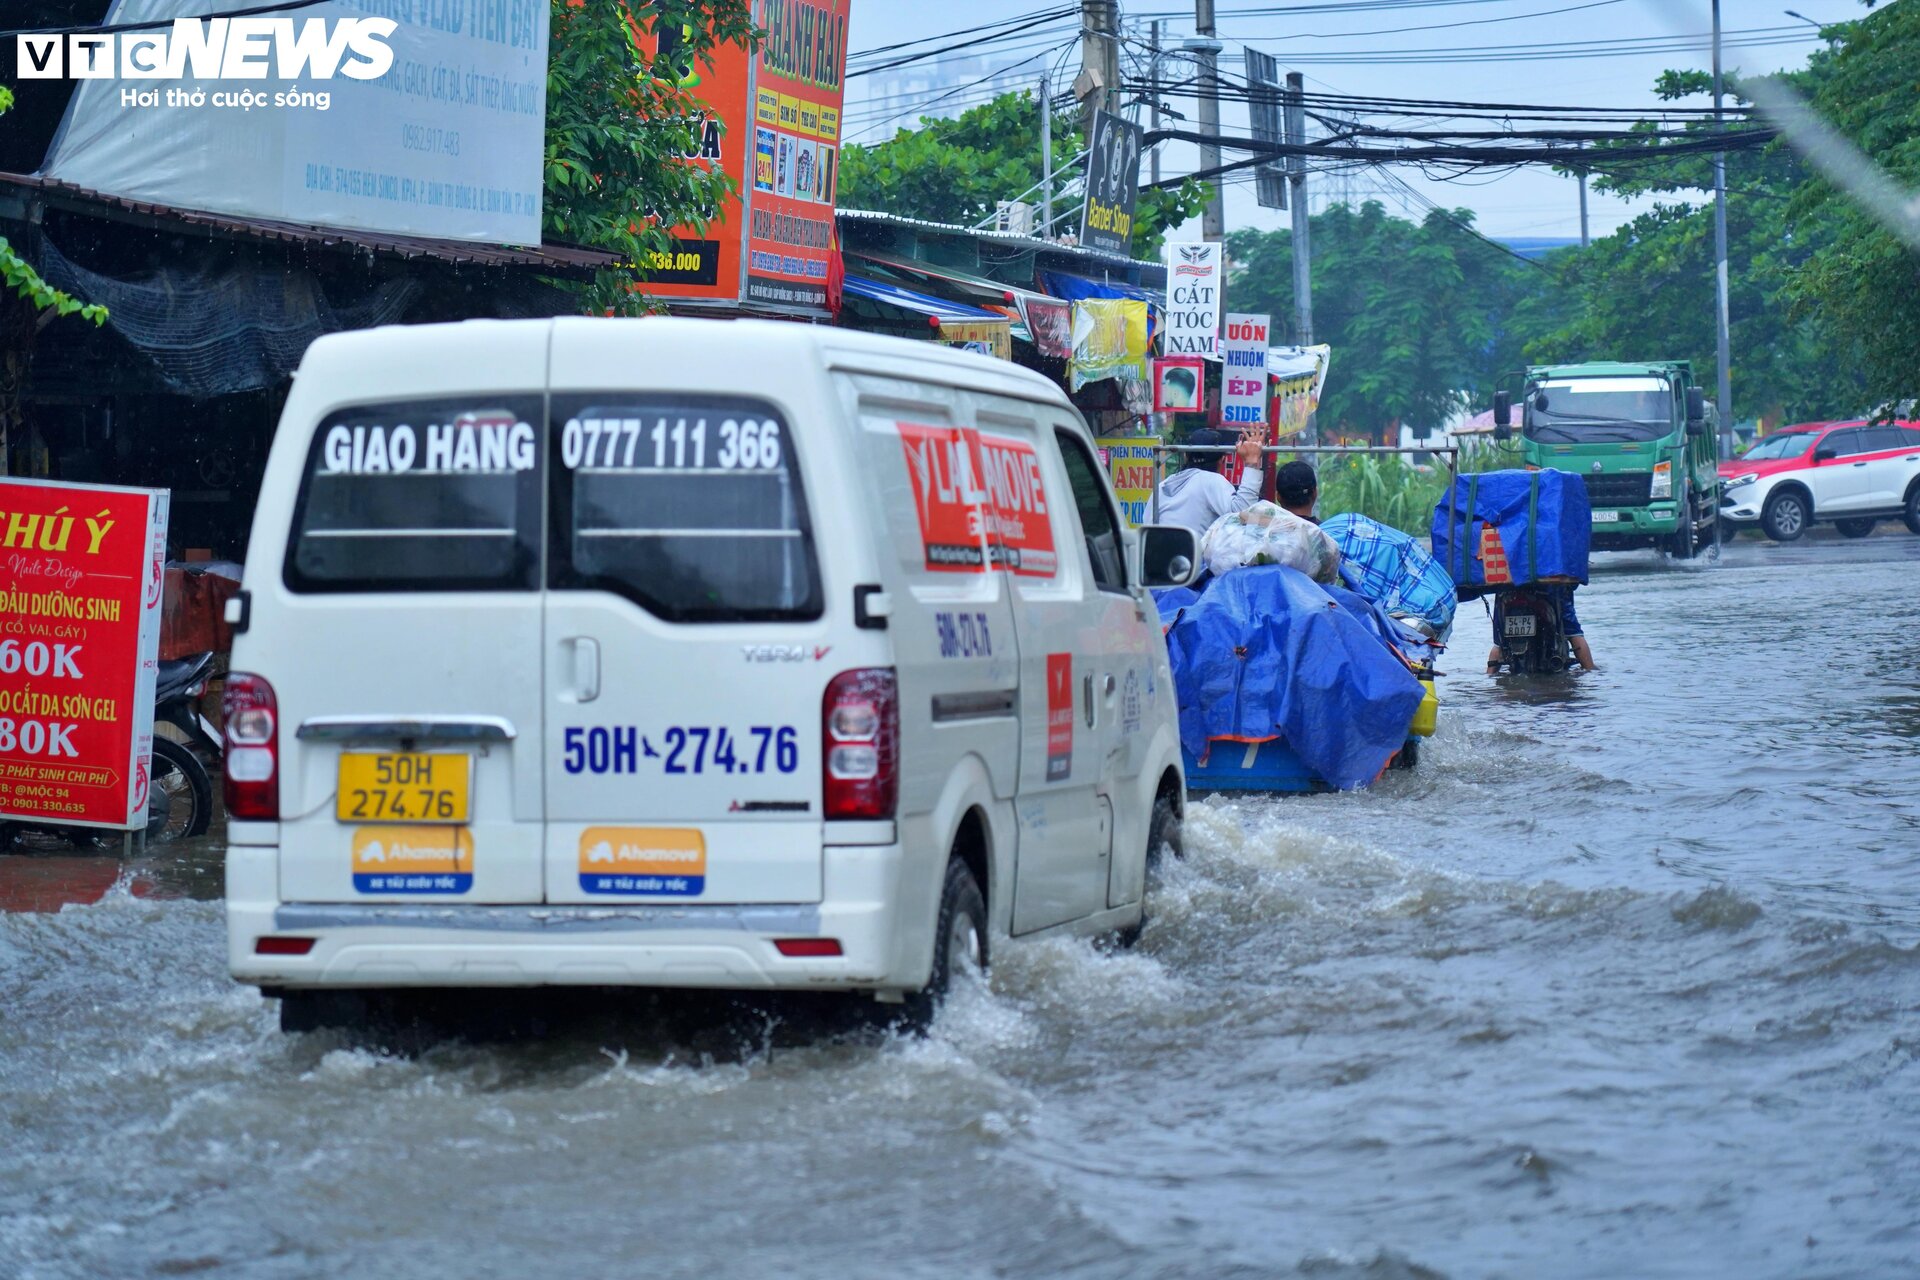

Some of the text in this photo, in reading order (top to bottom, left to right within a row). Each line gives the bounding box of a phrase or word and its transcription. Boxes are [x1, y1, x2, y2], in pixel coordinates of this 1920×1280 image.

[403, 124, 460, 156] 0982.917.483
[1088, 197, 1130, 242] Barber Shop
[1174, 279, 1214, 304] CẮT
[1173, 307, 1213, 329] TÓC
[1228, 319, 1266, 341] UỐN
[1169, 336, 1215, 353] NAM
[1227, 347, 1264, 371] NHUỘM
[1227, 376, 1262, 396] ÉP
[1225, 405, 1261, 422] SIDE
[325, 425, 417, 474] GIAO
[562, 419, 779, 469] 0777 111 366
[0, 506, 75, 551] HÚ
[85, 508, 116, 554] Ý
[44, 558, 83, 589] Design
[31, 590, 84, 619] DƯỠNG
[86, 598, 121, 622] SINH
[0, 639, 84, 679] 60K
[12, 682, 39, 715] CẮT
[41, 694, 60, 717] DA
[62, 693, 91, 719] SƠN
[93, 699, 117, 721] GEL
[7, 765, 37, 778] PHÁT
[38, 768, 65, 780] SINH
[67, 771, 86, 783] CHI
[88, 771, 110, 784] PHÍ
[376, 756, 433, 785] 50H
[15, 785, 54, 798] @MỘC
[56, 788, 69, 798] 94
[350, 789, 454, 818] 274.76
[13, 798, 86, 813] 0901.330.635
[389, 841, 466, 861] Ahamove
[618, 843, 698, 862] Ahamove
